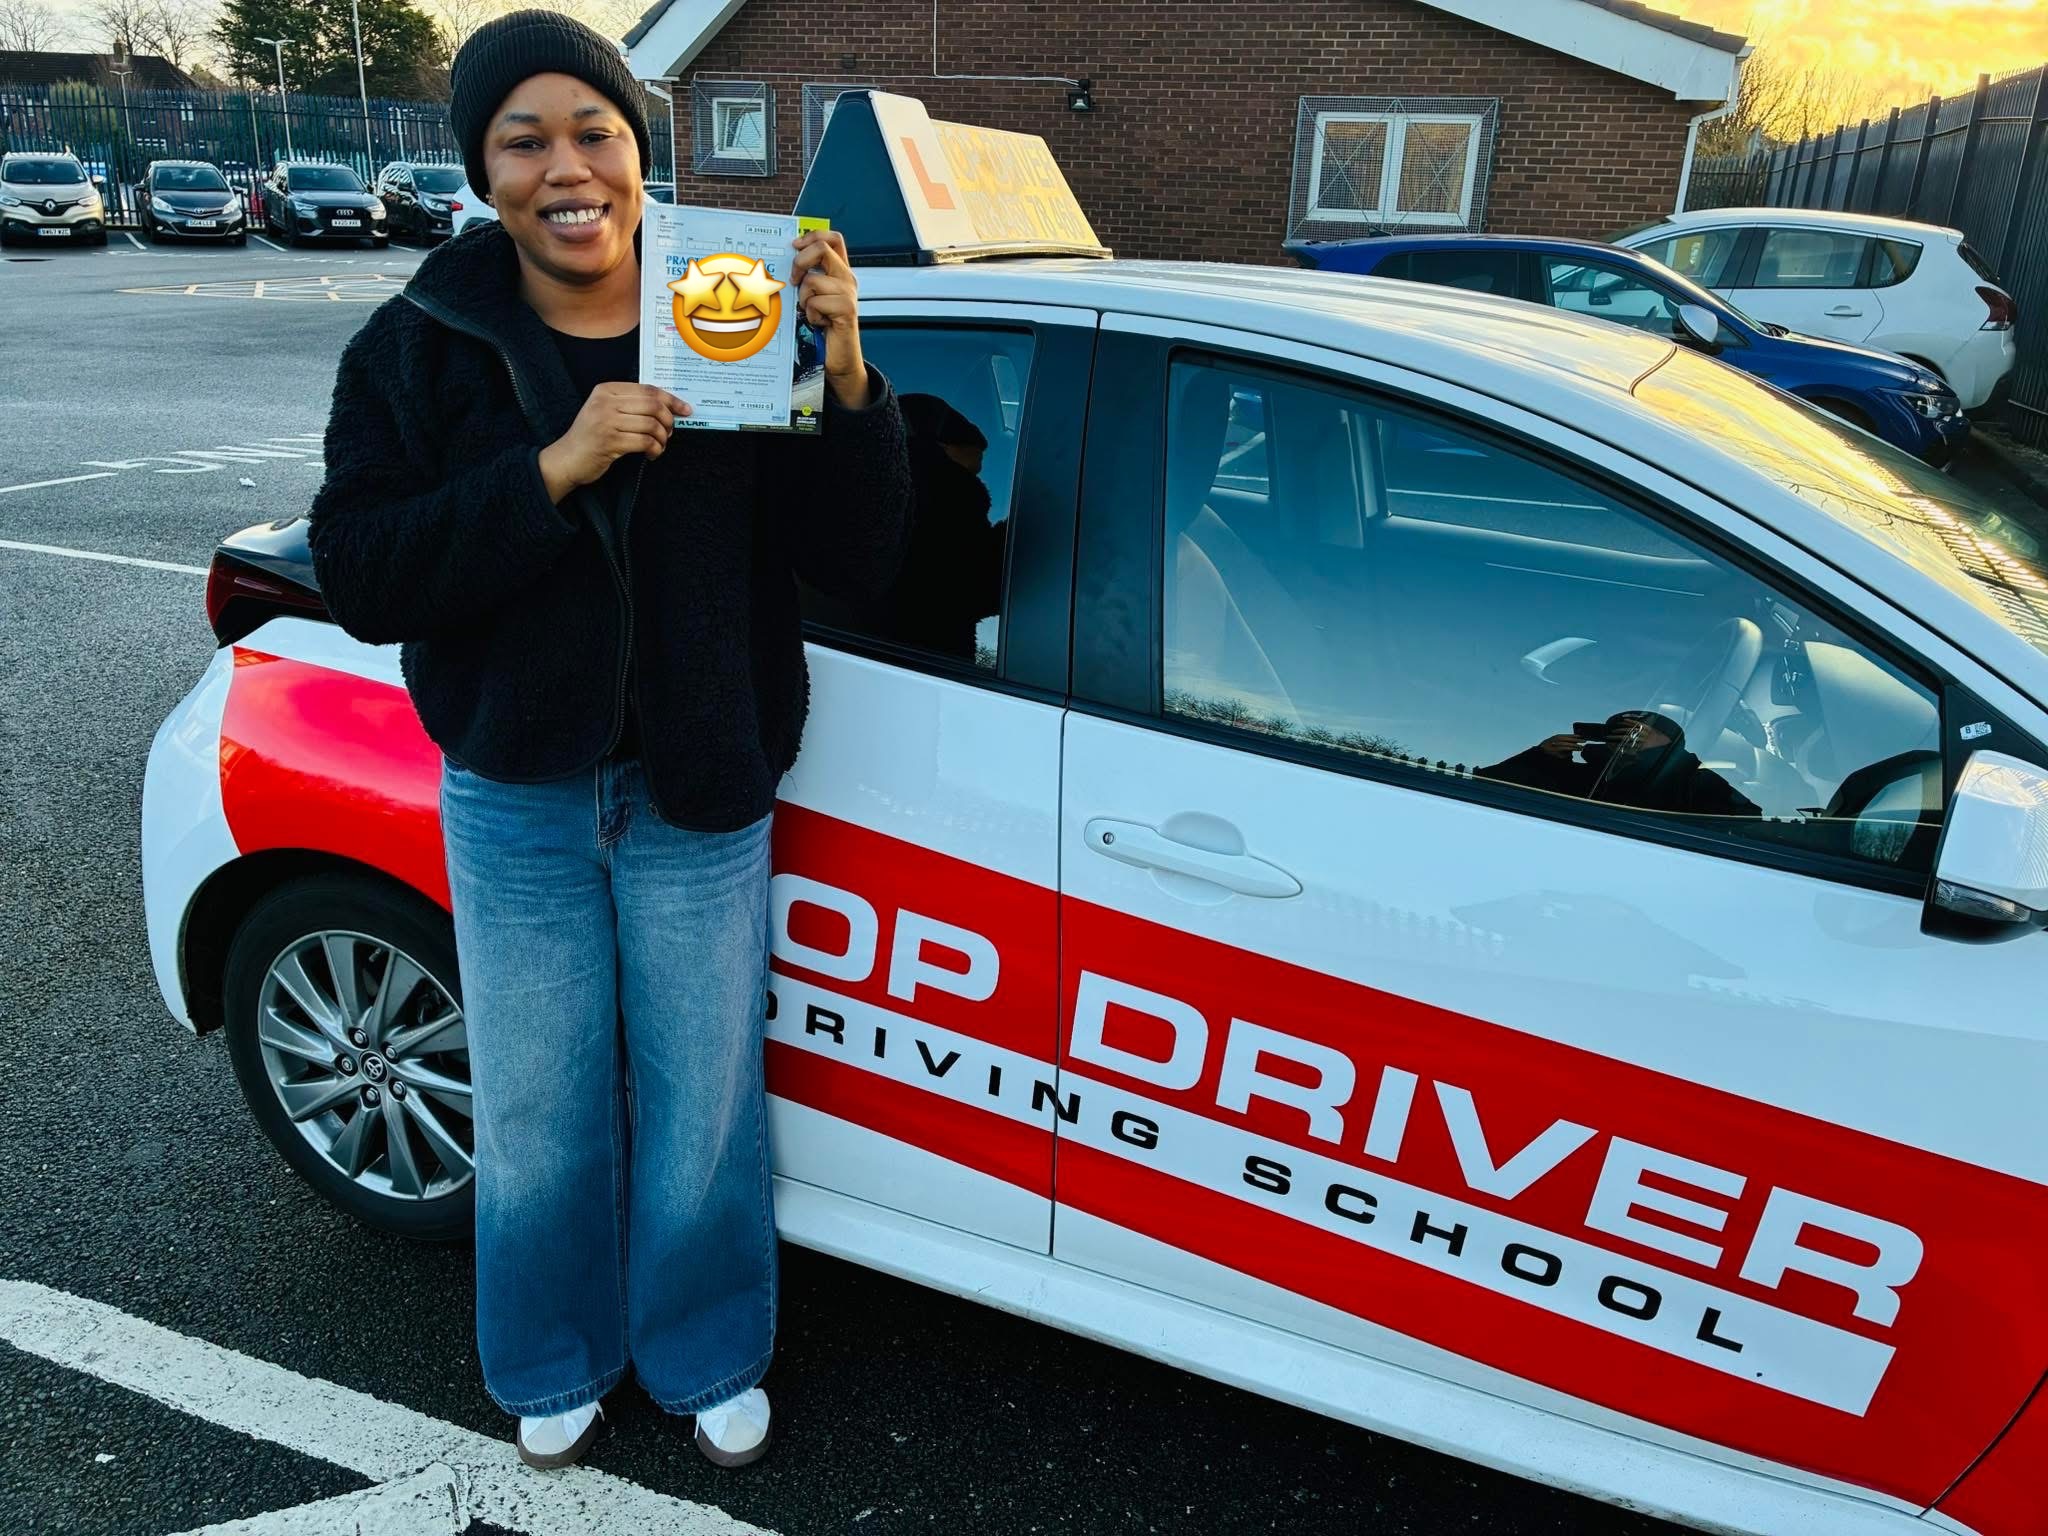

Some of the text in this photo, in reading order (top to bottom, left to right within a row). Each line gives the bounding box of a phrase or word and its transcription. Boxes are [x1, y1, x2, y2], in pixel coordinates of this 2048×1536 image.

[902, 137, 955, 209] L
[770, 873, 1924, 1328] OP DRIVER
[1242, 1155, 1743, 1353] SCHOOL
